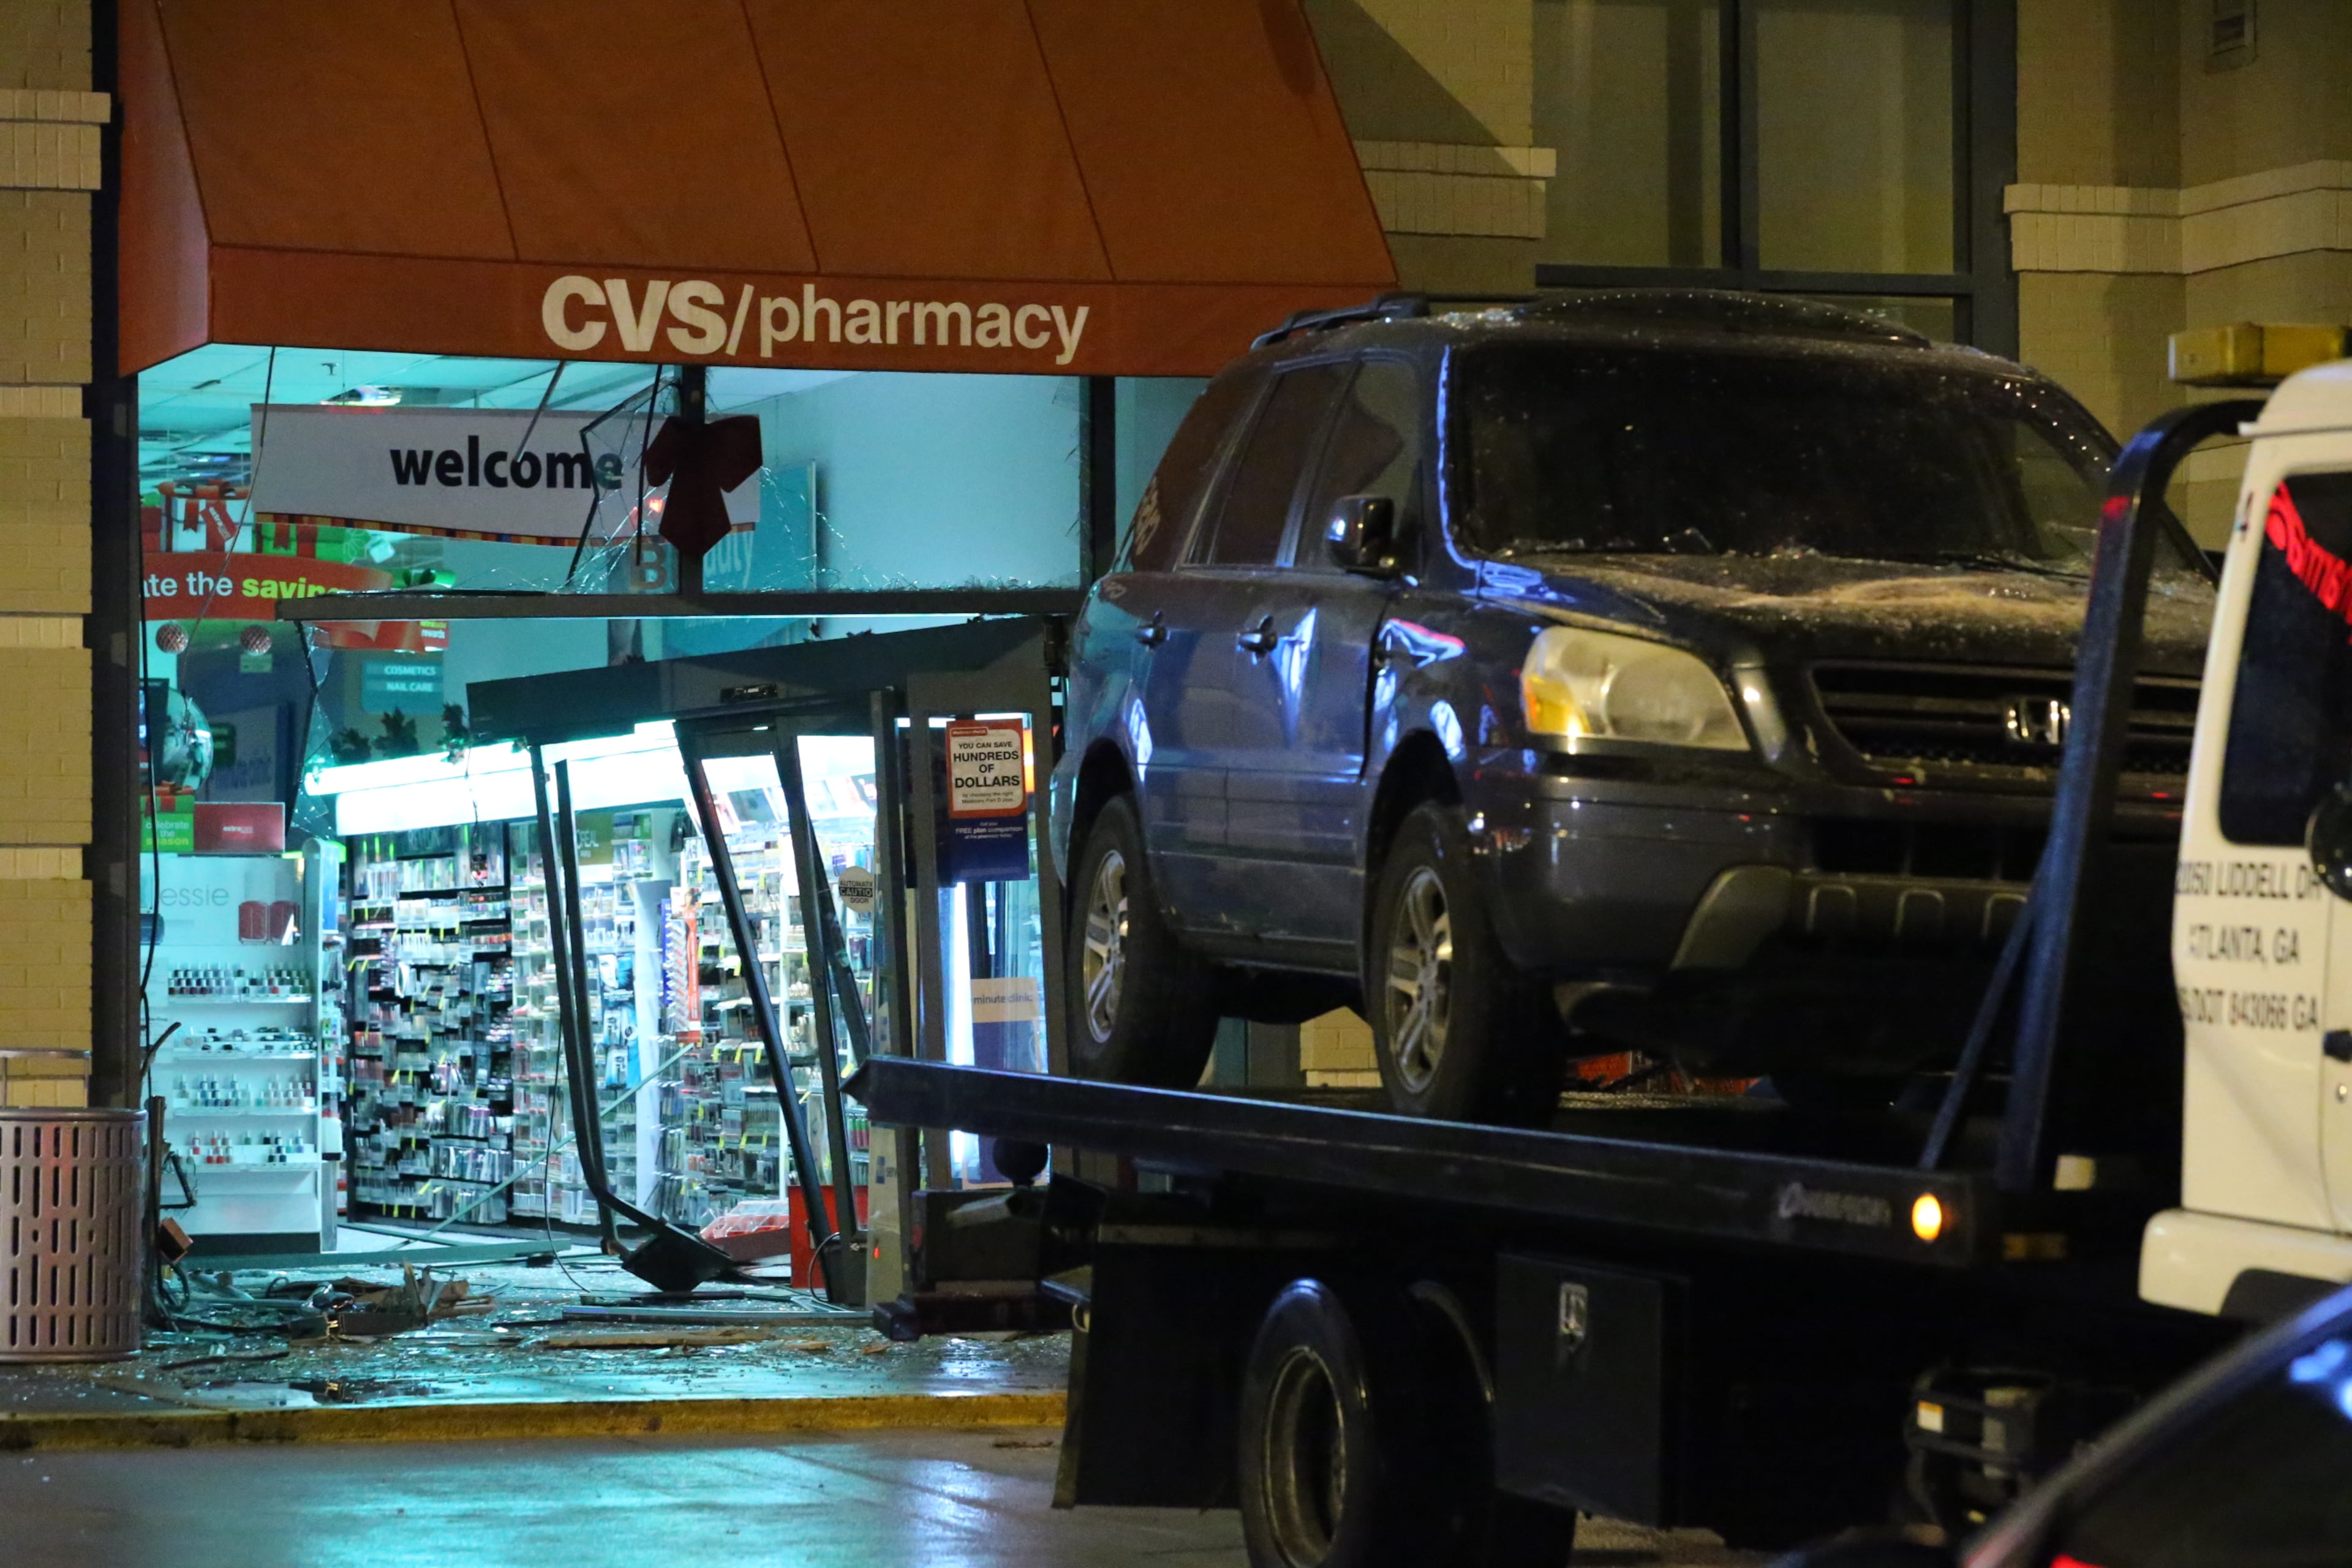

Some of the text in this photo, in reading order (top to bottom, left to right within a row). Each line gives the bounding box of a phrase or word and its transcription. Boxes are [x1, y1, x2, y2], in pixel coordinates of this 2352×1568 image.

[541, 275, 1089, 365] CVS/pharmacy
[390, 435, 624, 490] welcome
[186, 571, 233, 597] the
[384, 666, 436, 676] COSMETICS
[386, 682, 434, 693] NAIL CARE
[953, 750, 1019, 763] HUNDREDS
[978, 764, 995, 774] OF
[954, 775, 1020, 788] DOLLARS
[145, 820, 189, 830] clebrate
[160, 829, 175, 838] the
[146, 837, 189, 846] sason
[2217, 862, 2289, 899] LIDDELL
[160, 884, 230, 907] essie
[840, 887, 873, 897] CAUTIO
[2272, 927, 2301, 965] GA
[973, 992, 1033, 1005] minute clinic
[2292, 994, 2319, 1031] GA
